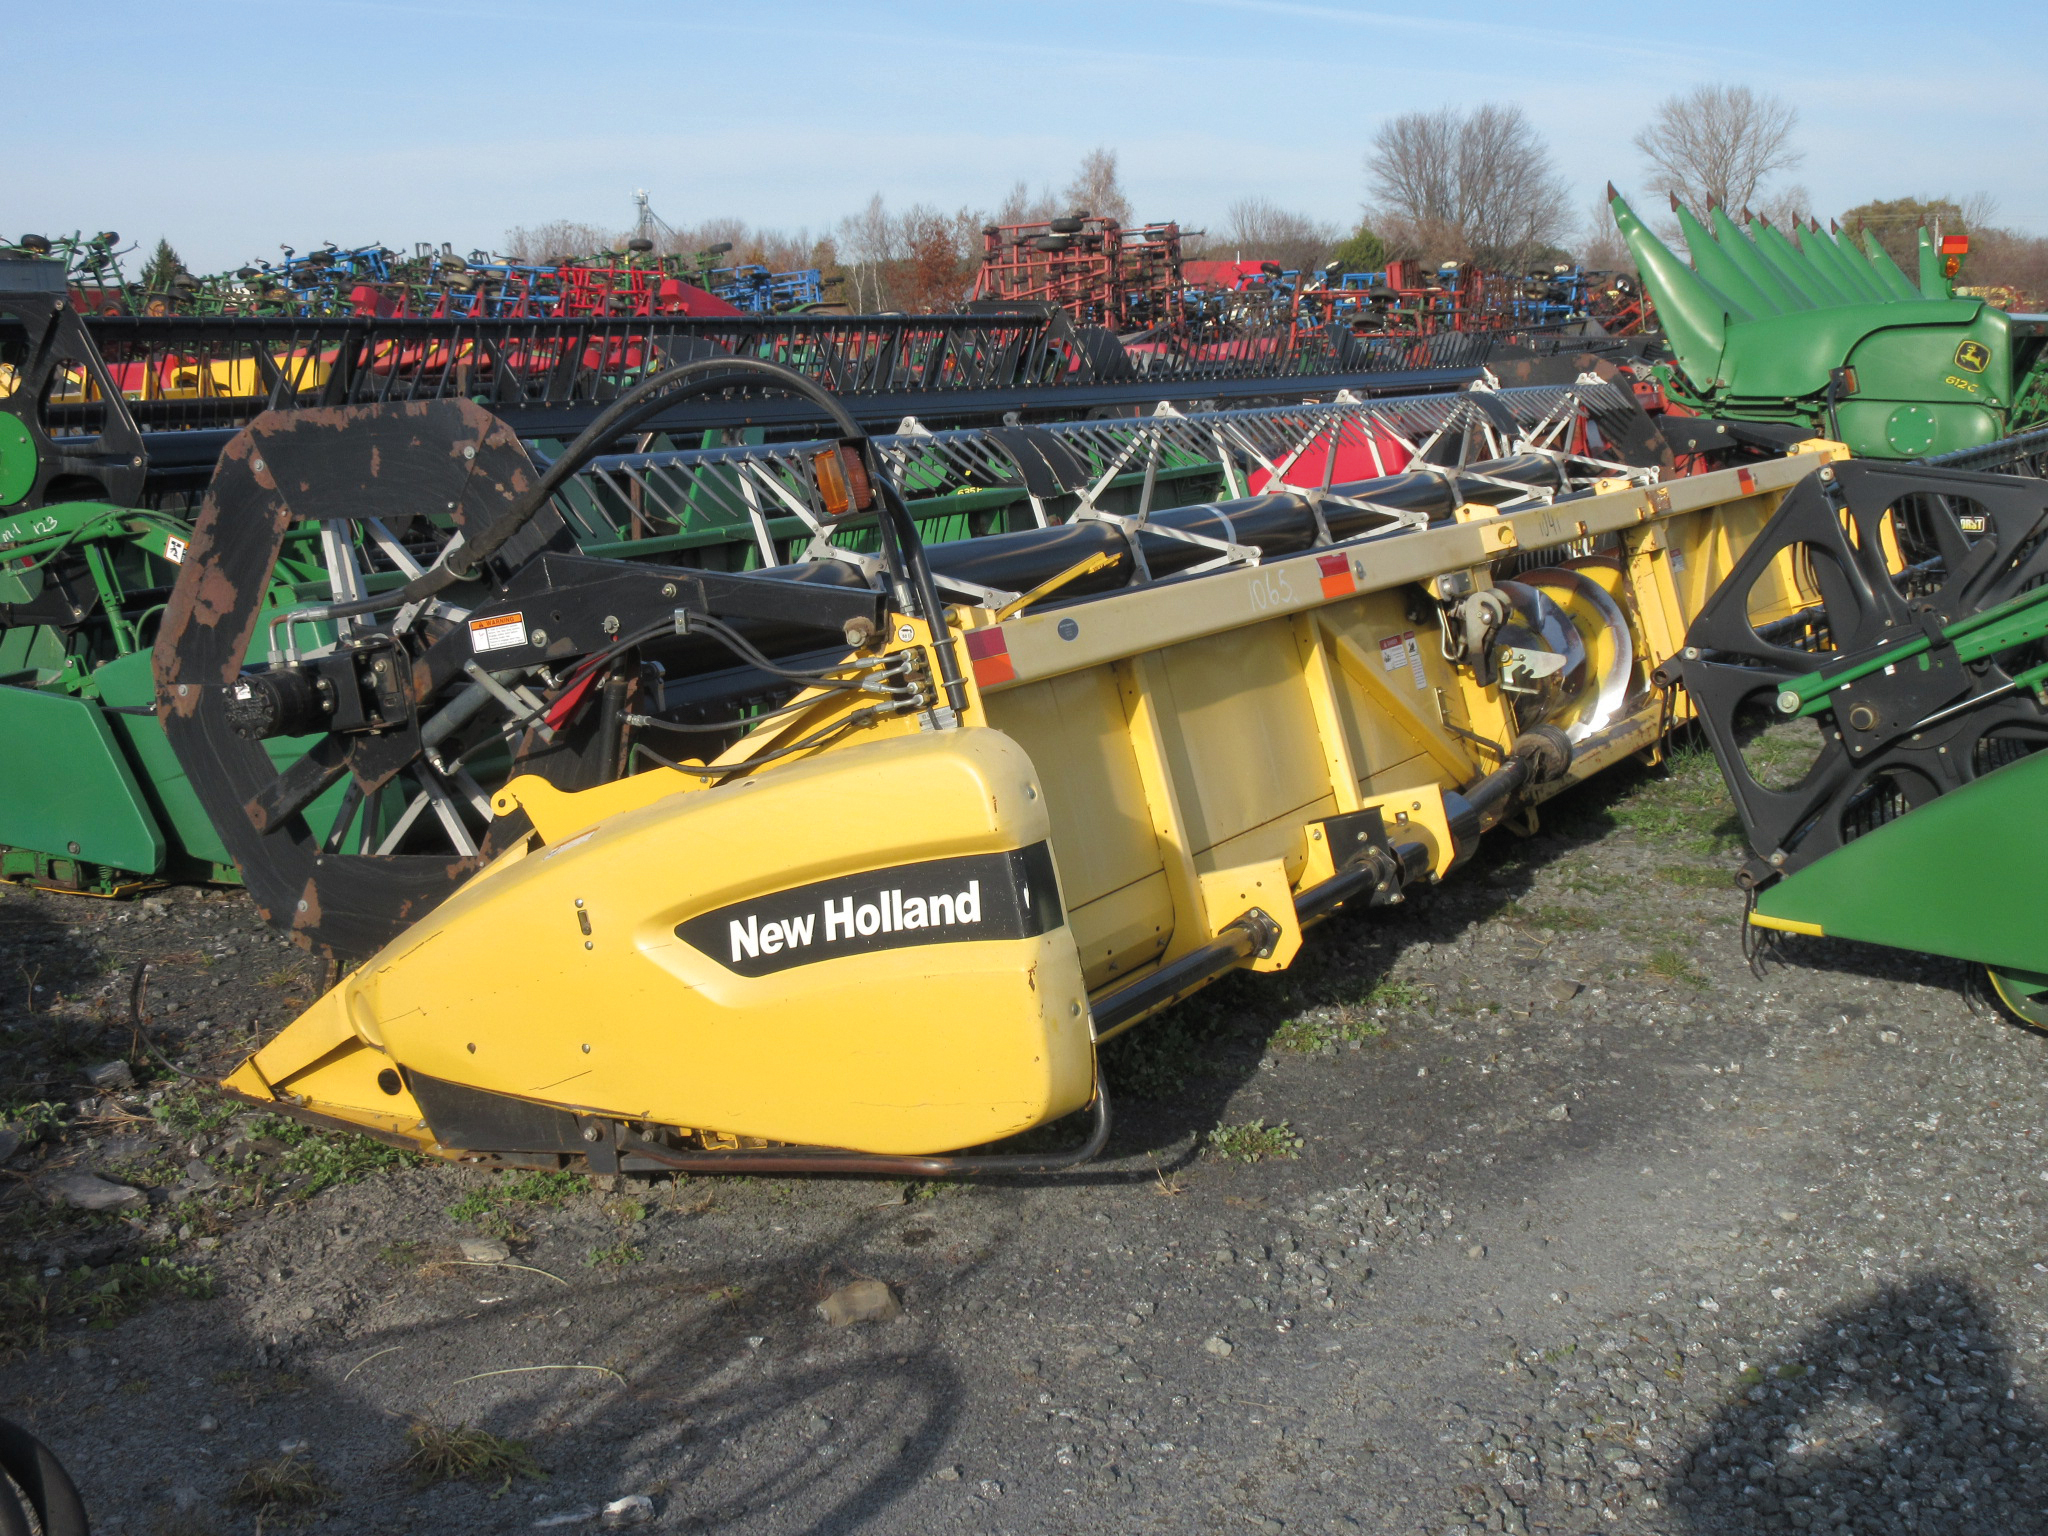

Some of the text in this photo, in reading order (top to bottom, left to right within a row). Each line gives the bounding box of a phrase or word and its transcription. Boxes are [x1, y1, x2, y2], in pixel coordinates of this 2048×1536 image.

[1945, 375, 1979, 393] 612C
[33, 516, 58, 536] 123
[1960, 518, 1983, 531] ORST
[1247, 569, 1293, 612] 1065
[486, 616, 515, 627] WARNING
[729, 879, 982, 963] New Holland
